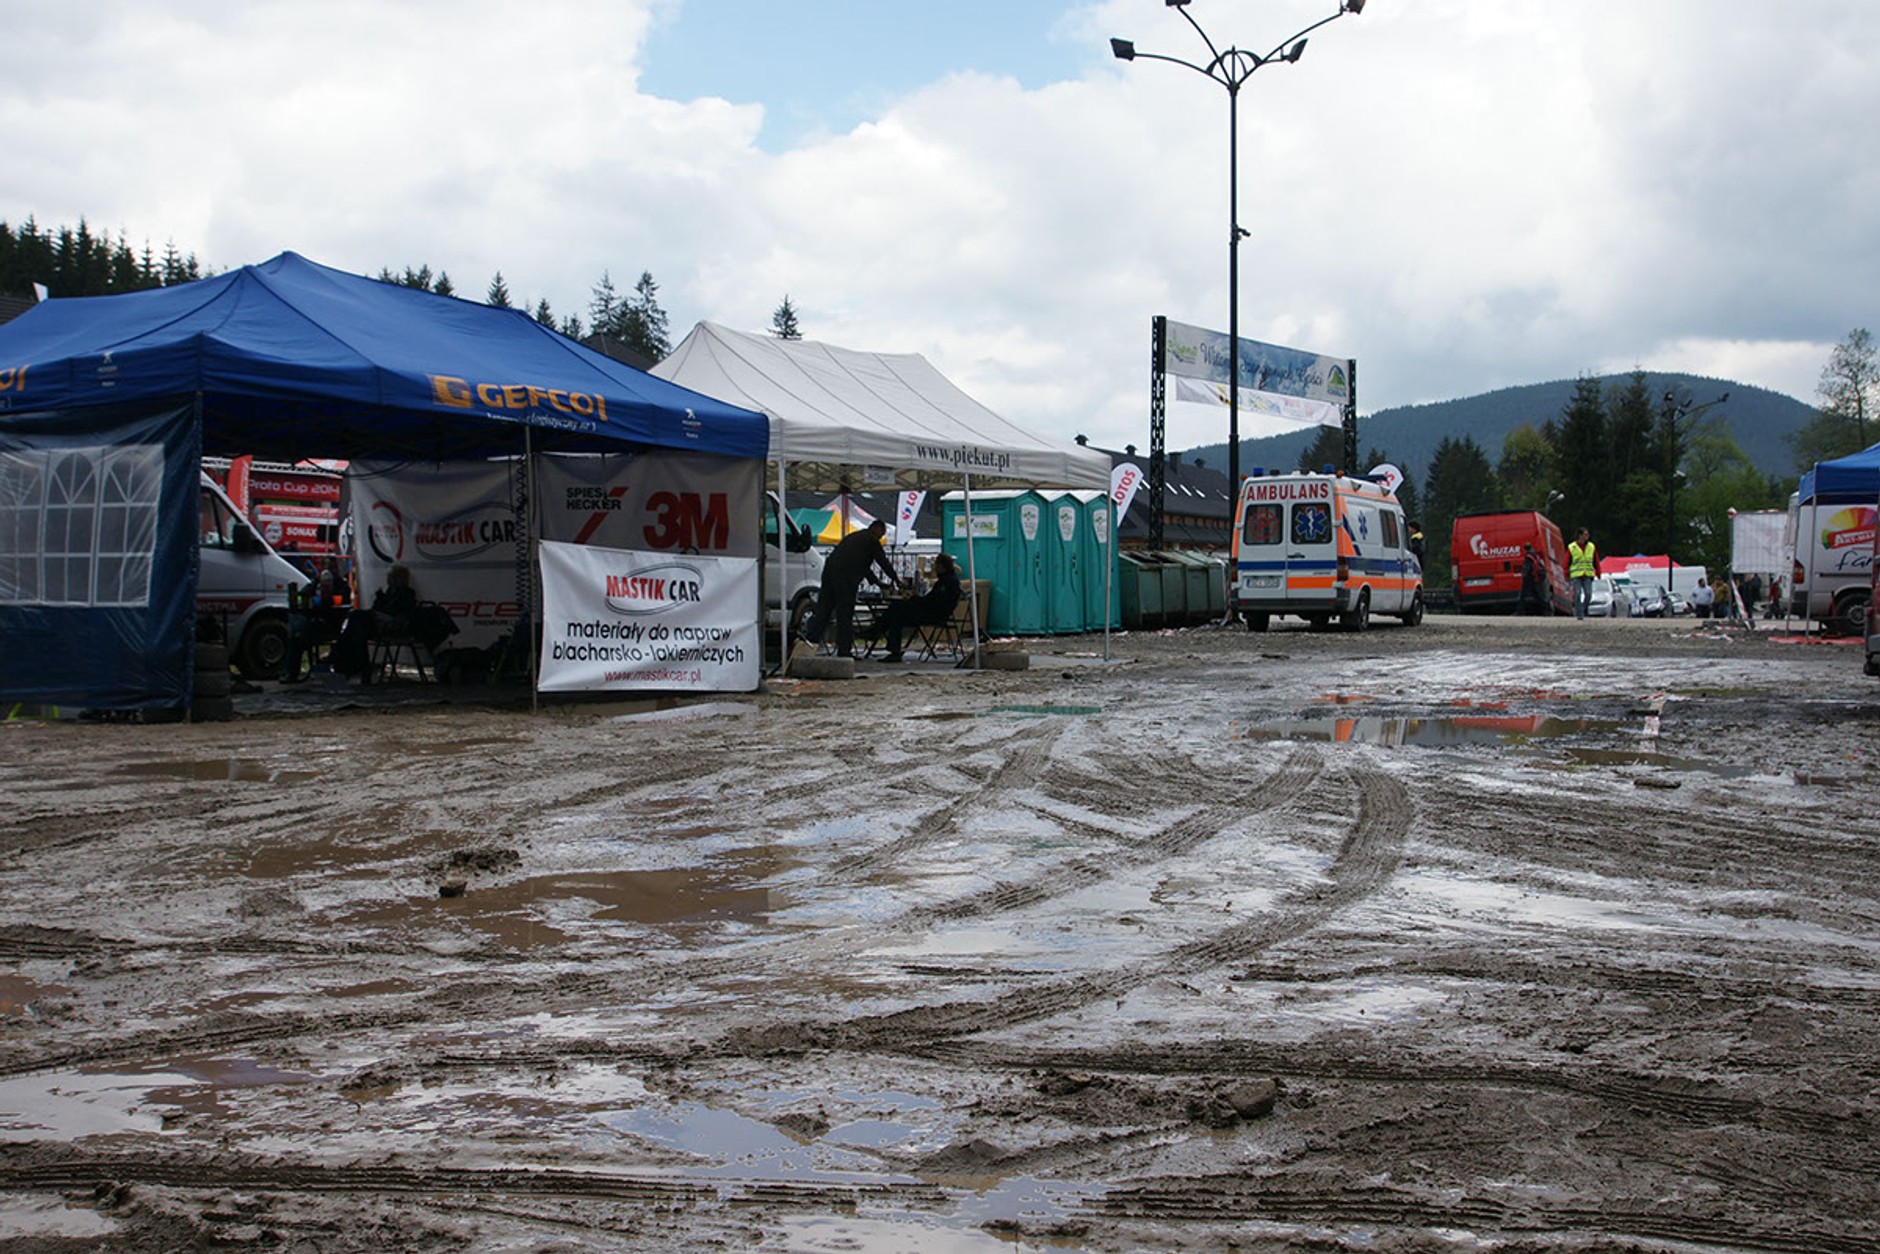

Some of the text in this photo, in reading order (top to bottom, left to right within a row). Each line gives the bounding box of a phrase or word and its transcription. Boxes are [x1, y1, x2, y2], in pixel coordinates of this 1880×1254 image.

[917, 445, 1010, 473] www.piekut.pl
[283, 481, 308, 494] Cup
[311, 484, 340, 495] 2014
[1247, 482, 1329, 501] AMBULANS
[566, 499, 622, 511] HECKER
[643, 491, 729, 549] 3M
[286, 526, 318, 537] SONAX
[414, 522, 476, 544] MASTIK
[480, 520, 516, 542] CAR
[606, 575, 701, 602] MASTIK CAR
[567, 622, 731, 645] materiały do napraw
[604, 668, 702, 684] www.mastikcar.pl
